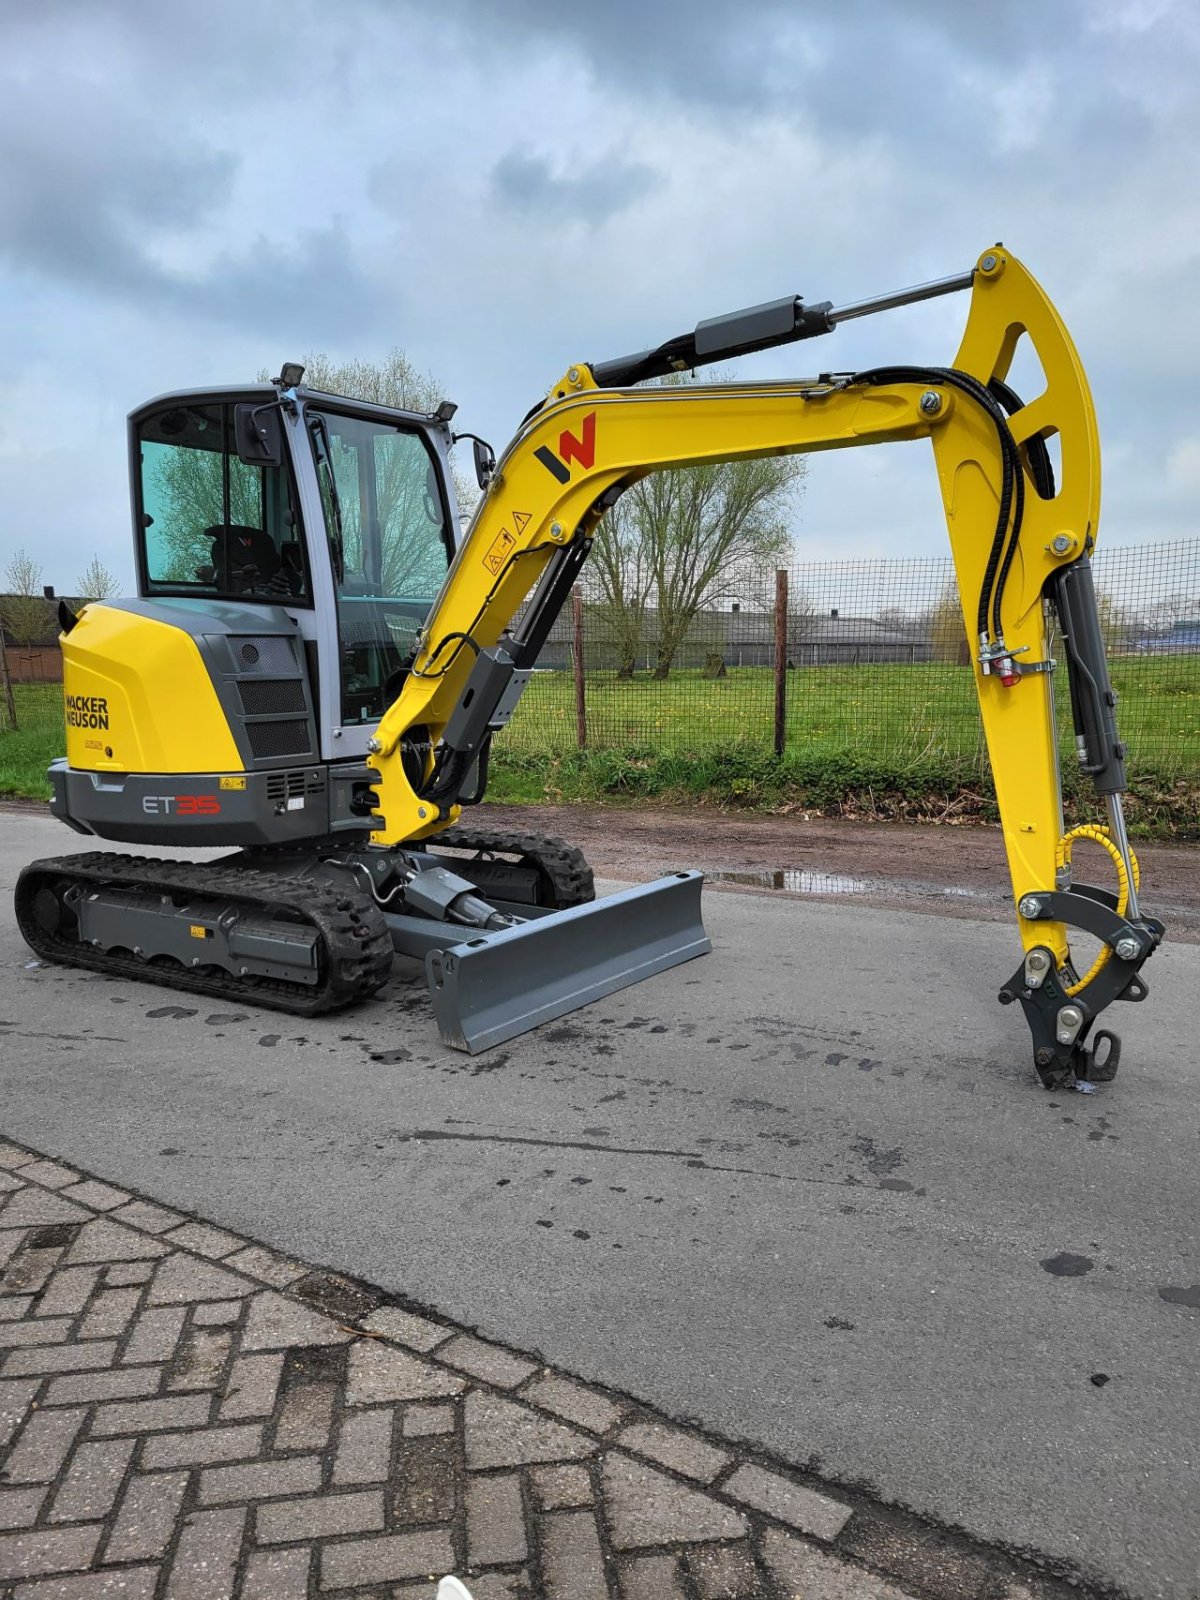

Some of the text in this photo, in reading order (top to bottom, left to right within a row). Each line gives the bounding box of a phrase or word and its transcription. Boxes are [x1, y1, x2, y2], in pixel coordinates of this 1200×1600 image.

[66, 695, 108, 714] WACKER
[66, 711, 109, 730] NEUSON
[142, 795, 222, 815] ET35
